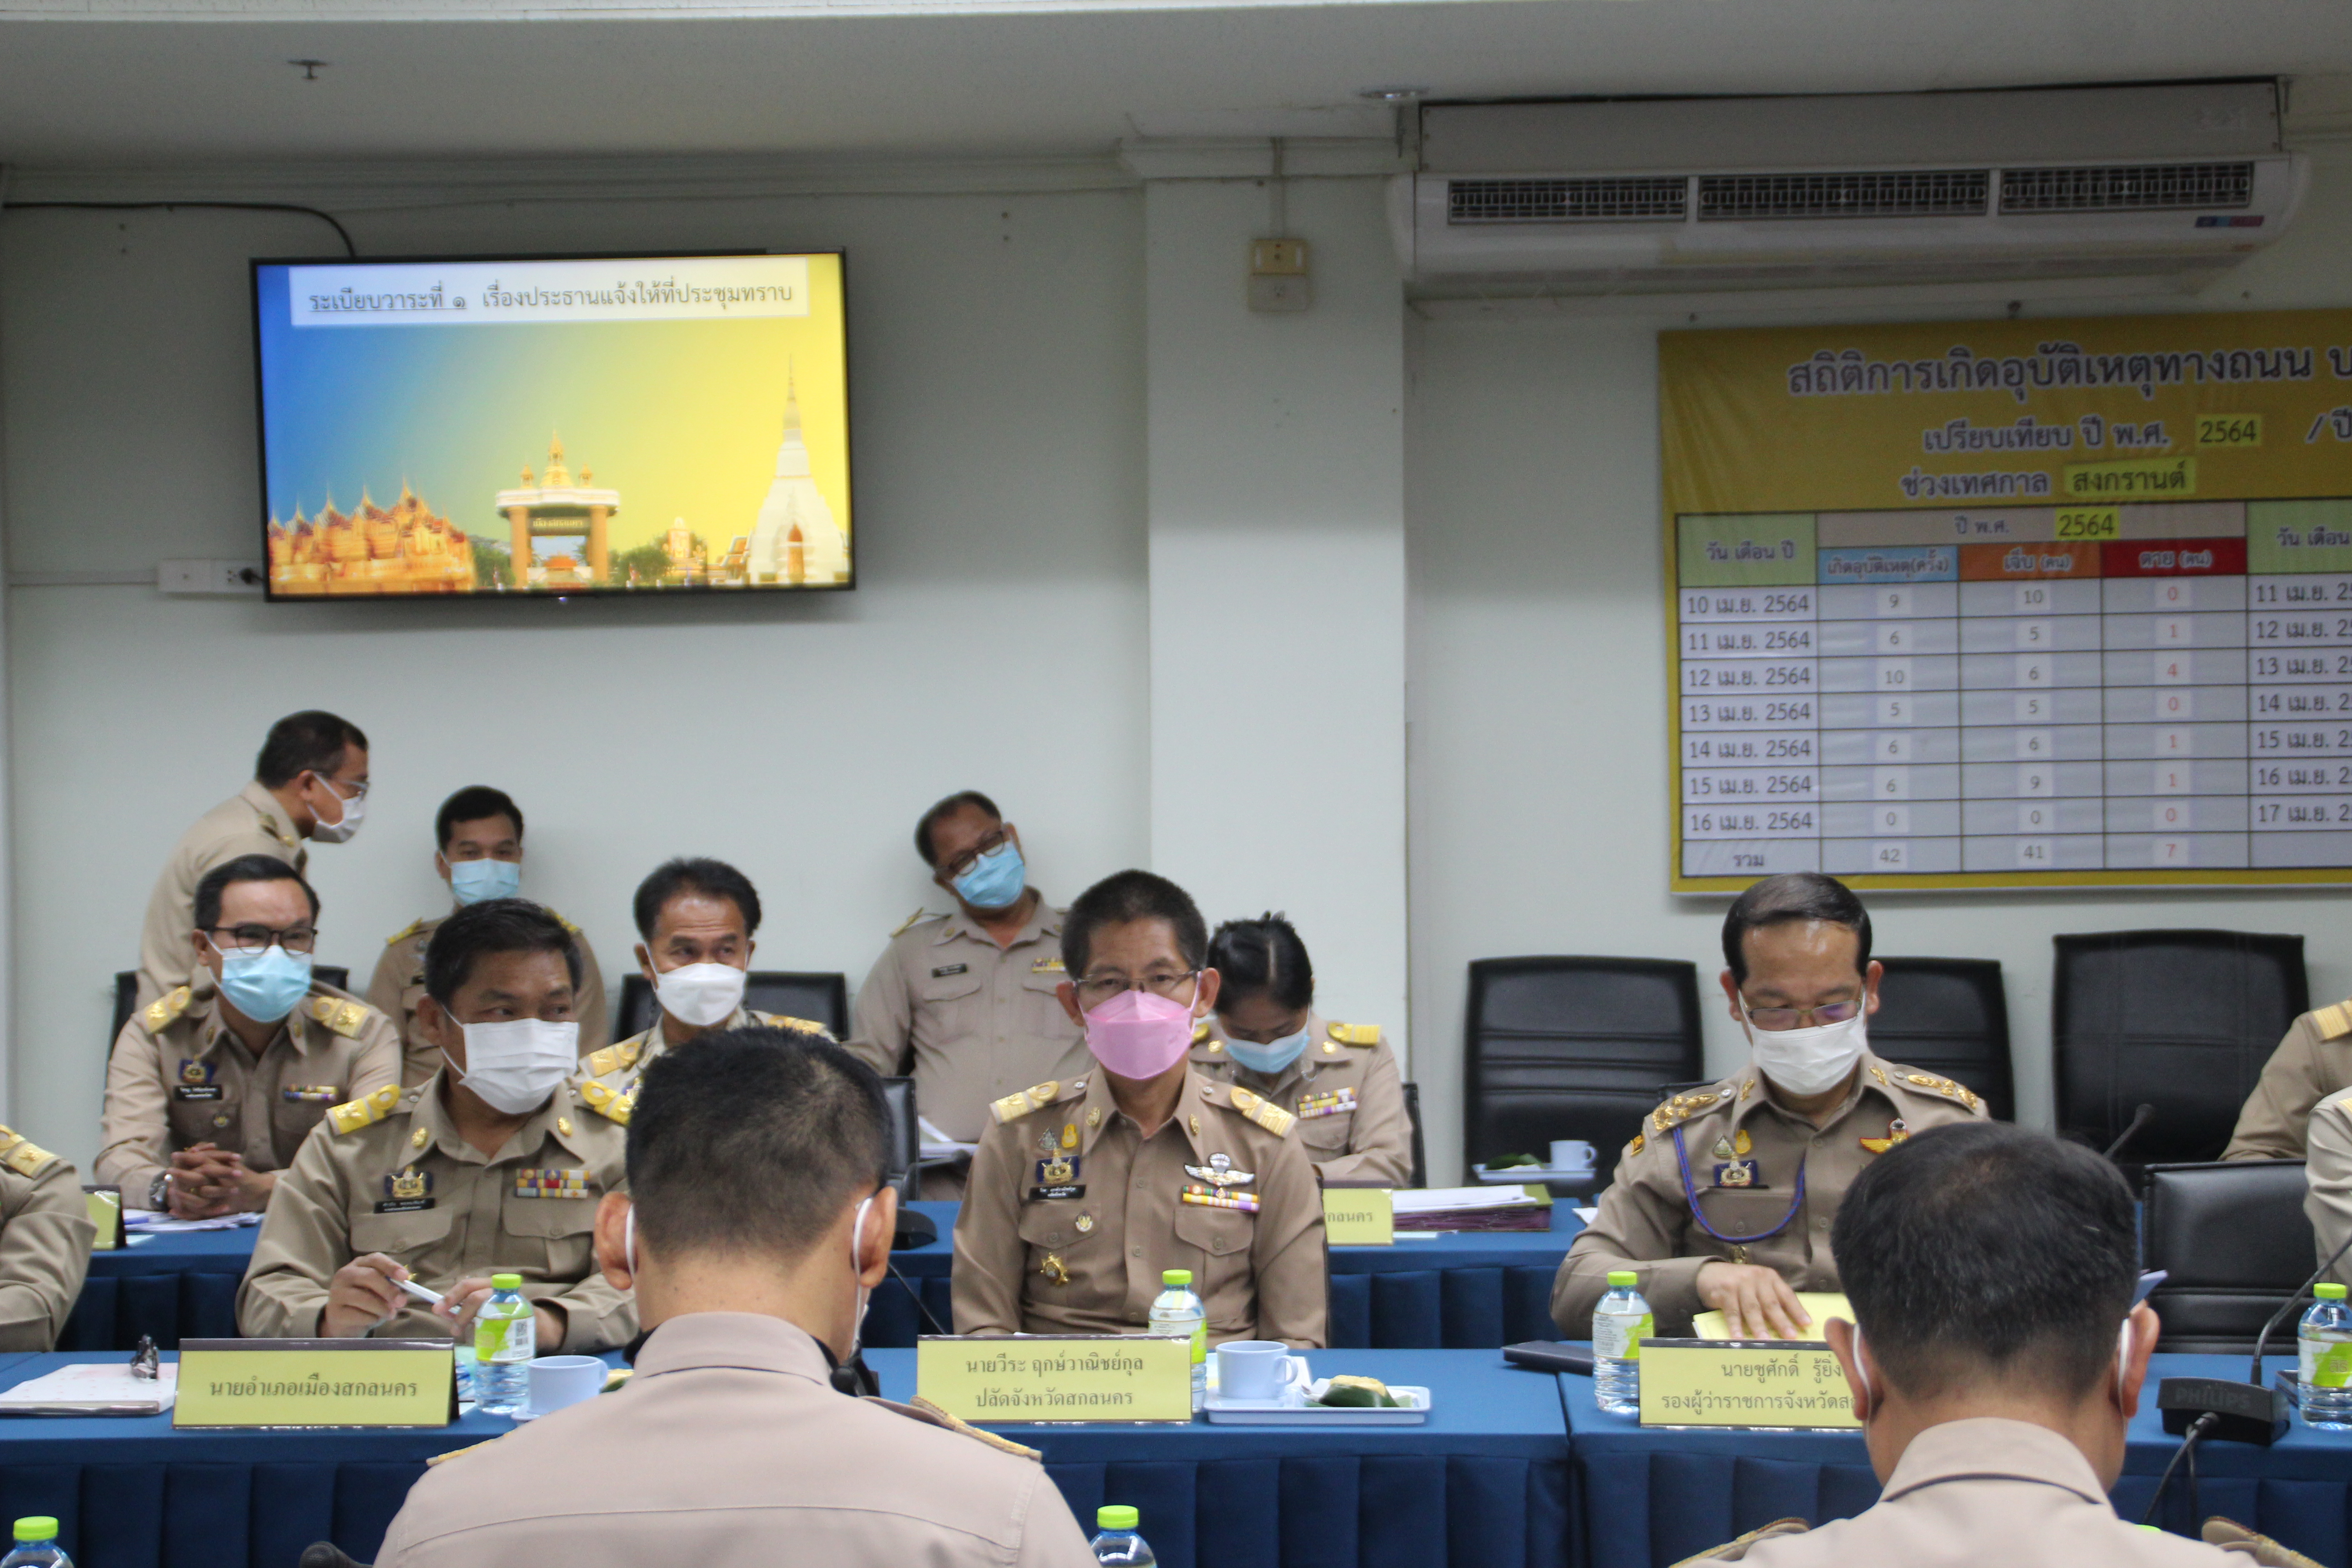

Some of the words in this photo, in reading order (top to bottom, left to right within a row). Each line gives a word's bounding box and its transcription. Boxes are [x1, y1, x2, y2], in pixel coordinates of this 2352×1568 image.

[309, 279, 443, 309] ระเบียบวาระที่
[453, 295, 466, 309] ๑
[482, 275, 793, 310] เรื่องประธานแจ้งให้ที่ประชุมทราบ
[1788, 342, 2312, 401] สถิติการเกิดอุบัติเหตุทางถนน
[1924, 417, 2072, 450] เปรียบเทียบ
[2080, 415, 2102, 446] ปี
[2113, 422, 2169, 445] พ.ศ.
[2200, 419, 2257, 443] 2564
[1901, 467, 2048, 495] ช่วงเทศกาล
[2073, 461, 2185, 492] สงกรานต์
[1955, 515, 1967, 534] ปี
[1975, 518, 2009, 534] พ.ศ.
[2058, 514, 2115, 537] 2564
[1706, 541, 1727, 560] วัน
[1735, 540, 1774, 560] เดือน
[1781, 540, 1794, 559] ปี
[2277, 526, 2300, 546] วัน
[2004, 548, 2035, 570] เจ็บ
[2140, 551, 2175, 568] ตาย
[1688, 596, 1709, 613] 10
[1764, 594, 1809, 612] 2564
[1889, 594, 1899, 608] 9
[2023, 589, 2042, 604] 10
[2167, 586, 2178, 601] 0
[2257, 584, 2277, 603] 11
[1689, 633, 1708, 650] 11
[1765, 631, 1810, 649] 2564
[1890, 630, 1899, 645] 6
[2029, 627, 2038, 641] 5
[2169, 624, 2176, 638] 1
[2257, 620, 2278, 638] 12
[1690, 669, 1710, 686] 12
[1765, 667, 1810, 685] 2564
[1885, 670, 1904, 684] 10
[2029, 666, 2039, 681] 6
[2167, 663, 2177, 677] 4
[2258, 657, 2278, 675] 13
[1690, 704, 1710, 722] 13
[1766, 703, 1810, 720] 2564
[1890, 702, 1900, 716] 5
[2029, 700, 2038, 714] 5
[2167, 697, 2178, 711] 0
[2259, 694, 2279, 712] 14
[1690, 740, 1710, 758] 14
[1766, 739, 1810, 757] 2564
[1888, 740, 1898, 754] 6
[2029, 736, 2039, 750] 6
[2169, 735, 2176, 749] 1
[2259, 730, 2279, 749] 15
[1690, 777, 1711, 794] 15
[1767, 775, 1811, 793] 2564
[1886, 779, 1896, 793] 6
[2029, 775, 2039, 790] 9
[2169, 773, 2176, 787] 1
[2259, 768, 2279, 785] 16
[1691, 813, 1711, 831] 16
[1768, 812, 1812, 829] 2564
[1886, 811, 1896, 826] 0
[2030, 810, 2041, 824] 0
[2166, 807, 2176, 822] 0
[2259, 804, 2280, 823] 17
[1733, 854, 1764, 867] รวม
[1880, 848, 1900, 863] 42
[2023, 845, 2043, 859] 41
[2165, 843, 2176, 857] 7
[966, 1352, 1026, 1373] นายวีระ
[1032, 1349, 1144, 1377] ฤกษ์วาณิชย์กุล
[1721, 1352, 1799, 1383] นายชูศักดิ์
[1813, 1354, 1841, 1383] รู้ยิ่ง
[210, 1372, 418, 1397] นายอำเภอเมืองสกลนคร
[976, 1387, 1133, 1407] ปลัดจังหวัดสกลนคร
